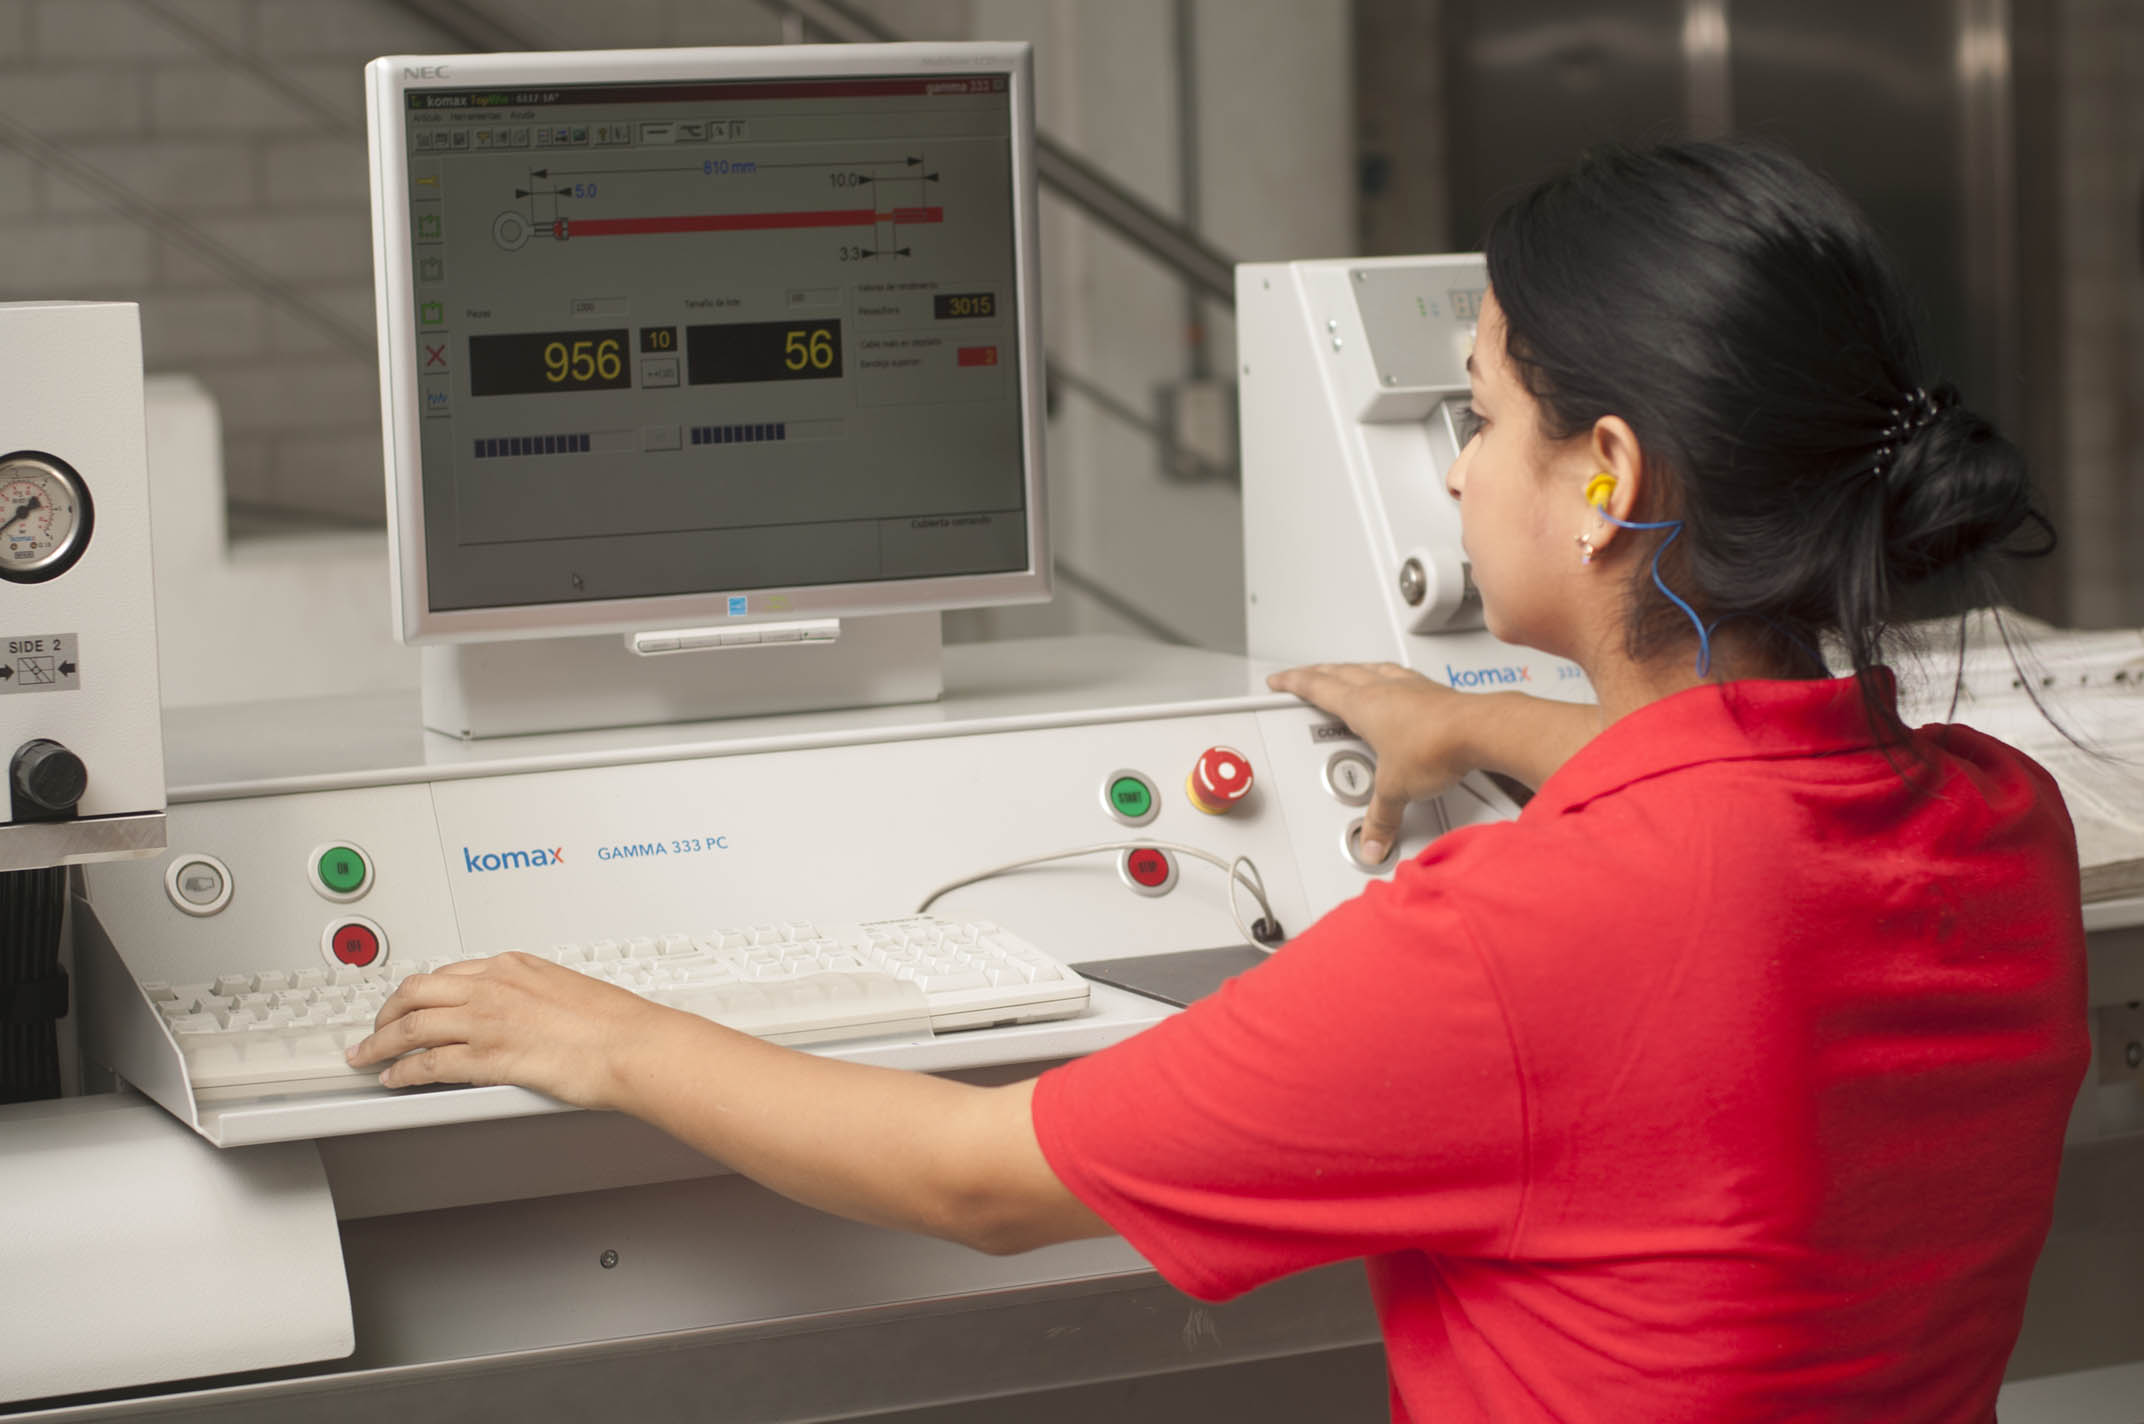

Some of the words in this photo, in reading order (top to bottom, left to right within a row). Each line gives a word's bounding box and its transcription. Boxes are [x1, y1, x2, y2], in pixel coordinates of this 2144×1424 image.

[403, 65, 450, 80] NEC
[426, 95, 468, 108] komax
[703, 159, 729, 175] 810
[731, 161, 757, 174] mm
[829, 173, 858, 188] 10.0
[574, 183, 598, 199] 5.0
[839, 246, 860, 262] 3.3
[950, 296, 991, 315] 3015
[544, 339, 622, 383] 956
[649, 330, 671, 349] 10
[785, 329, 834, 371] 56
[984, 349, 994, 363] 2
[9, 640, 44, 654] SIDE
[53, 638, 62, 651] 2
[1446, 664, 1533, 688] komax
[1556, 665, 1582, 680] 333
[1118, 790, 1143, 804] START
[463, 846, 565, 873] komax
[598, 842, 668, 861] GAMMA
[671, 838, 702, 854] 333
[706, 836, 730, 850] PC
[337, 862, 349, 876] ON
[346, 939, 363, 953] OFF
